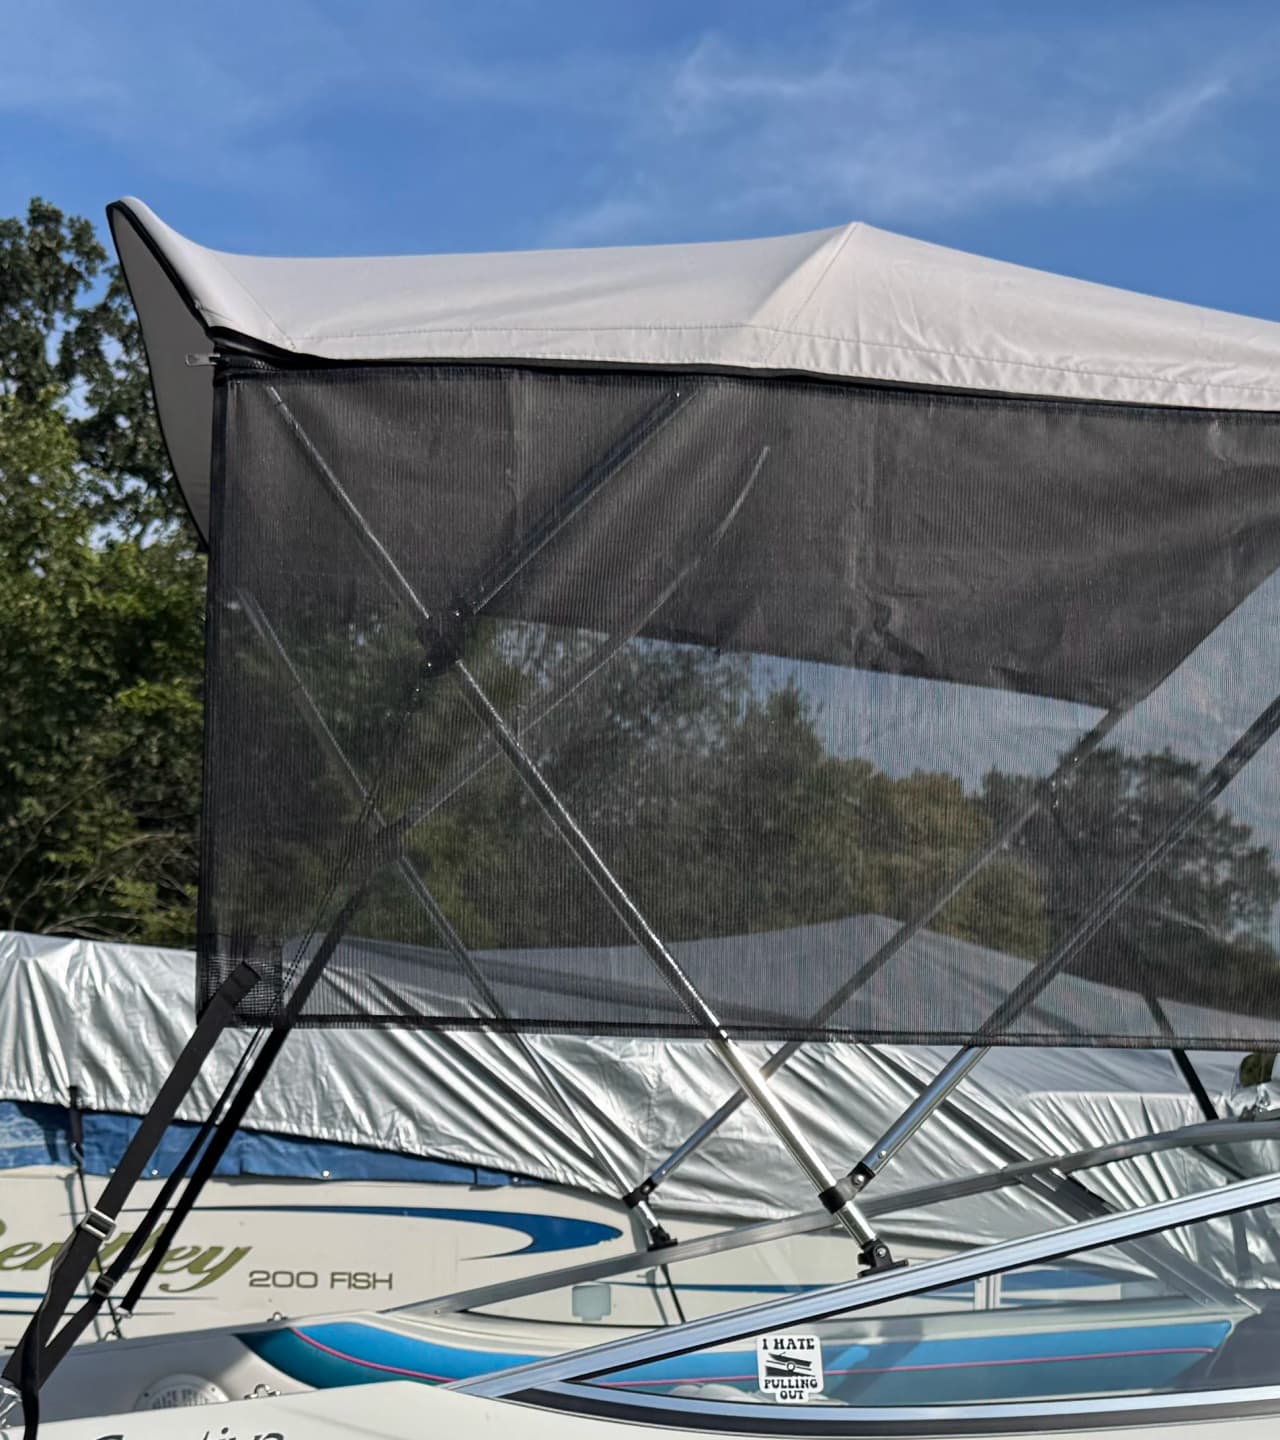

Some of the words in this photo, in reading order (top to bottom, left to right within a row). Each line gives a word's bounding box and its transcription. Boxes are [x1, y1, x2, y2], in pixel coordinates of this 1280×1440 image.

[249, 1270, 317, 1288] 200
[330, 1272, 393, 1290] FISH
[762, 1338, 768, 1350] I
[773, 1338, 815, 1350] HATE
[764, 1378, 818, 1389] PULLING
[780, 1390, 804, 1400] OUT
